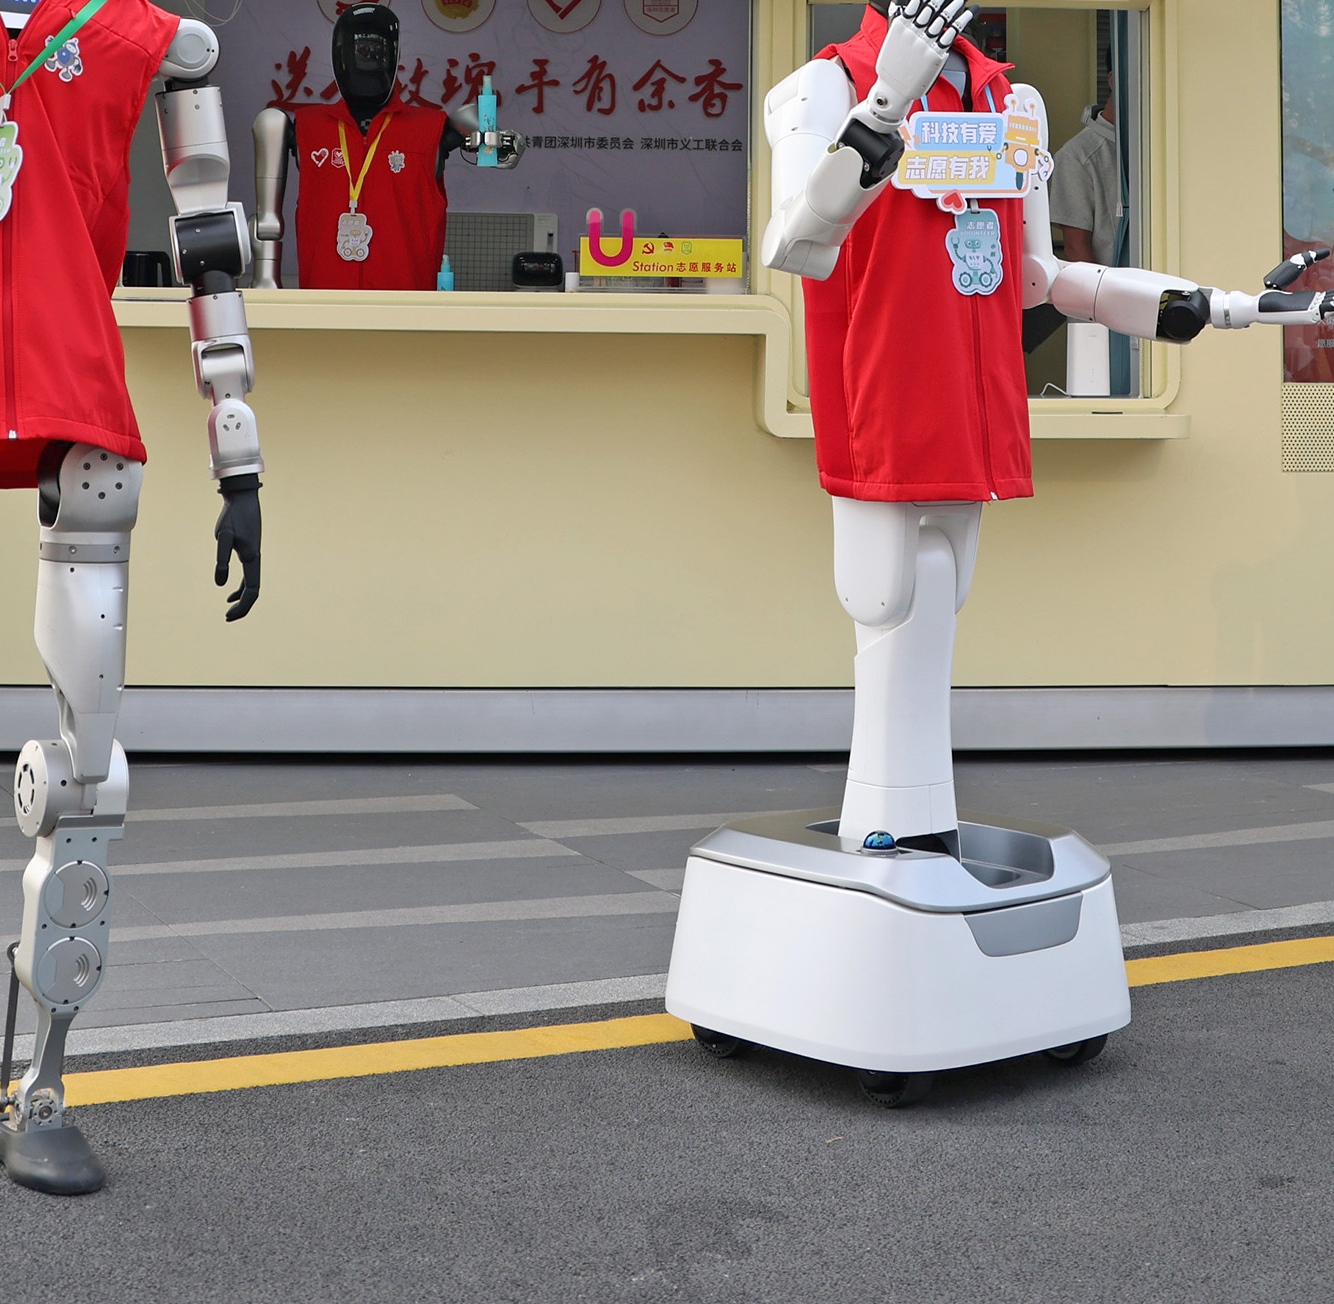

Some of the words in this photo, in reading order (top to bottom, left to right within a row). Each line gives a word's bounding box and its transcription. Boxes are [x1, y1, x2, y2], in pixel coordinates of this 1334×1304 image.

[921, 122, 998, 145] 科技有爱
[640, 137, 744, 152] 深圳市义工联合会
[905, 155, 990, 180] 志愿有我
[632, 260, 674, 273] Station
[675, 262, 737, 274] 志愿服务站
